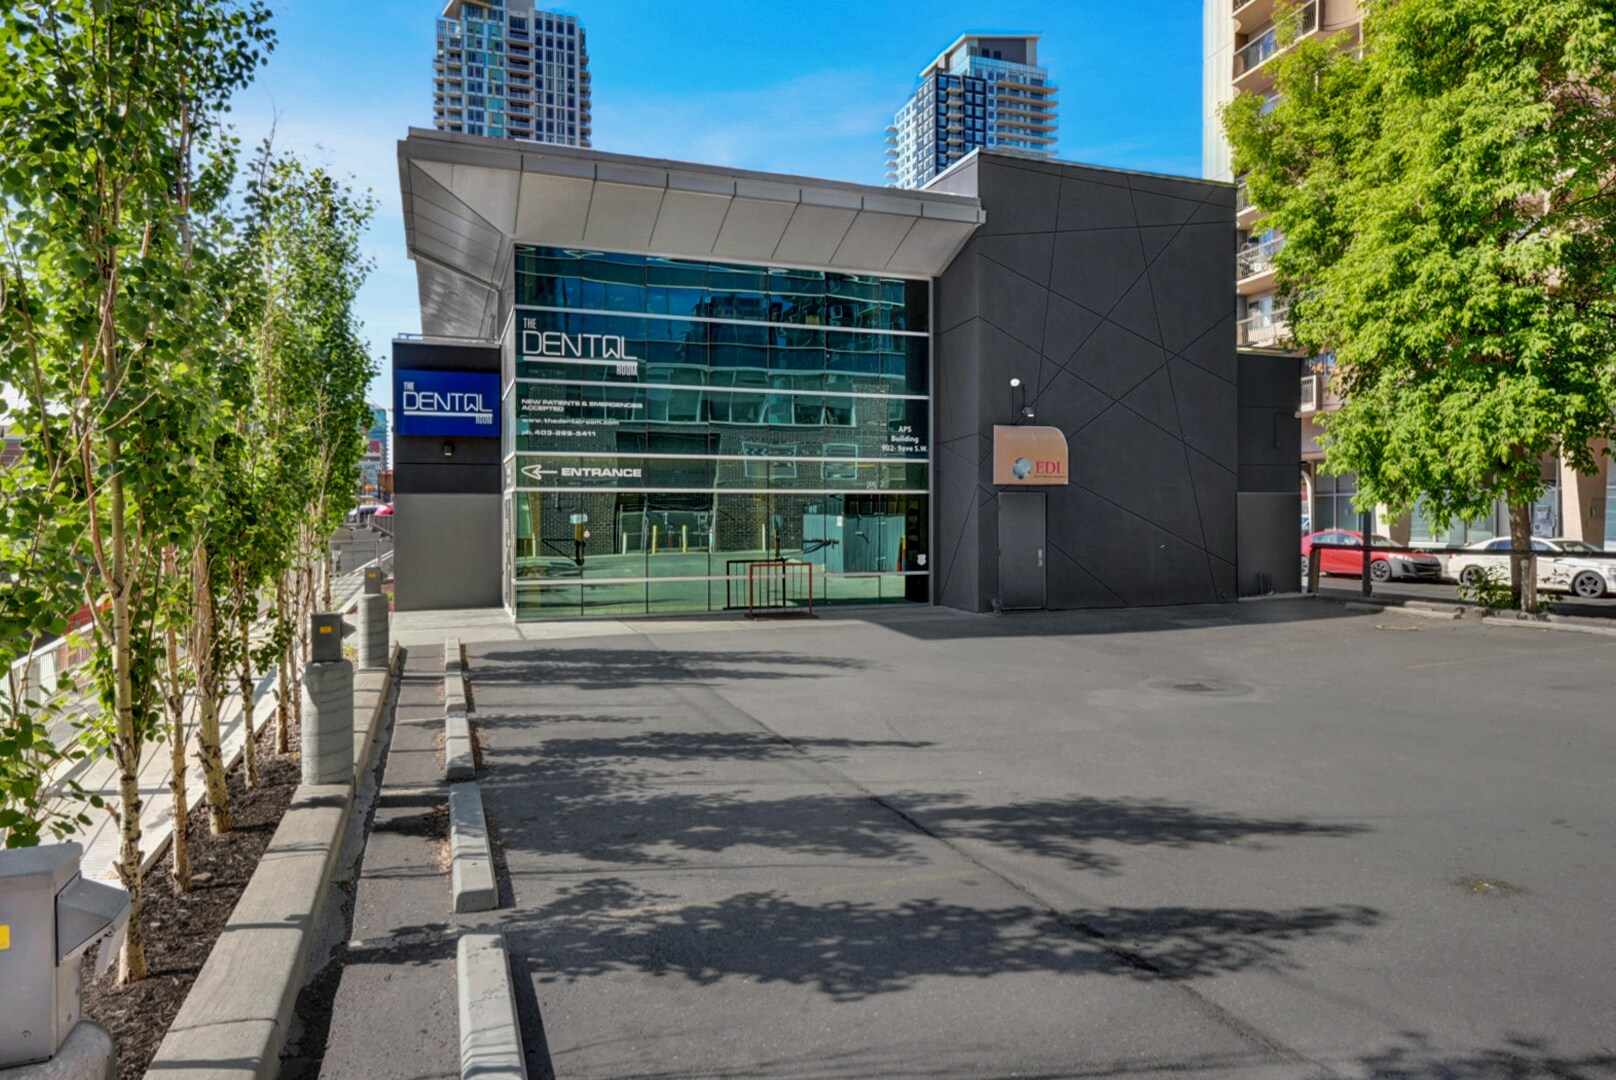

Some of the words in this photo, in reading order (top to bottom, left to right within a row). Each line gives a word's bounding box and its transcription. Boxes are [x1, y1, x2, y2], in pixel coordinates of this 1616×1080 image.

[523, 317, 537, 329] THE
[522, 330, 638, 360] DENTAL
[616, 364, 638, 376] ROOM
[403, 381, 415, 391] THE
[403, 391, 493, 412] DENTAL
[521, 417, 620, 426] www.thedentalroom.com
[898, 425, 912, 433] APS
[891, 434, 920, 444] Building
[561, 467, 642, 478] ENTRANCE
[1035, 461, 1061, 475] EDI
